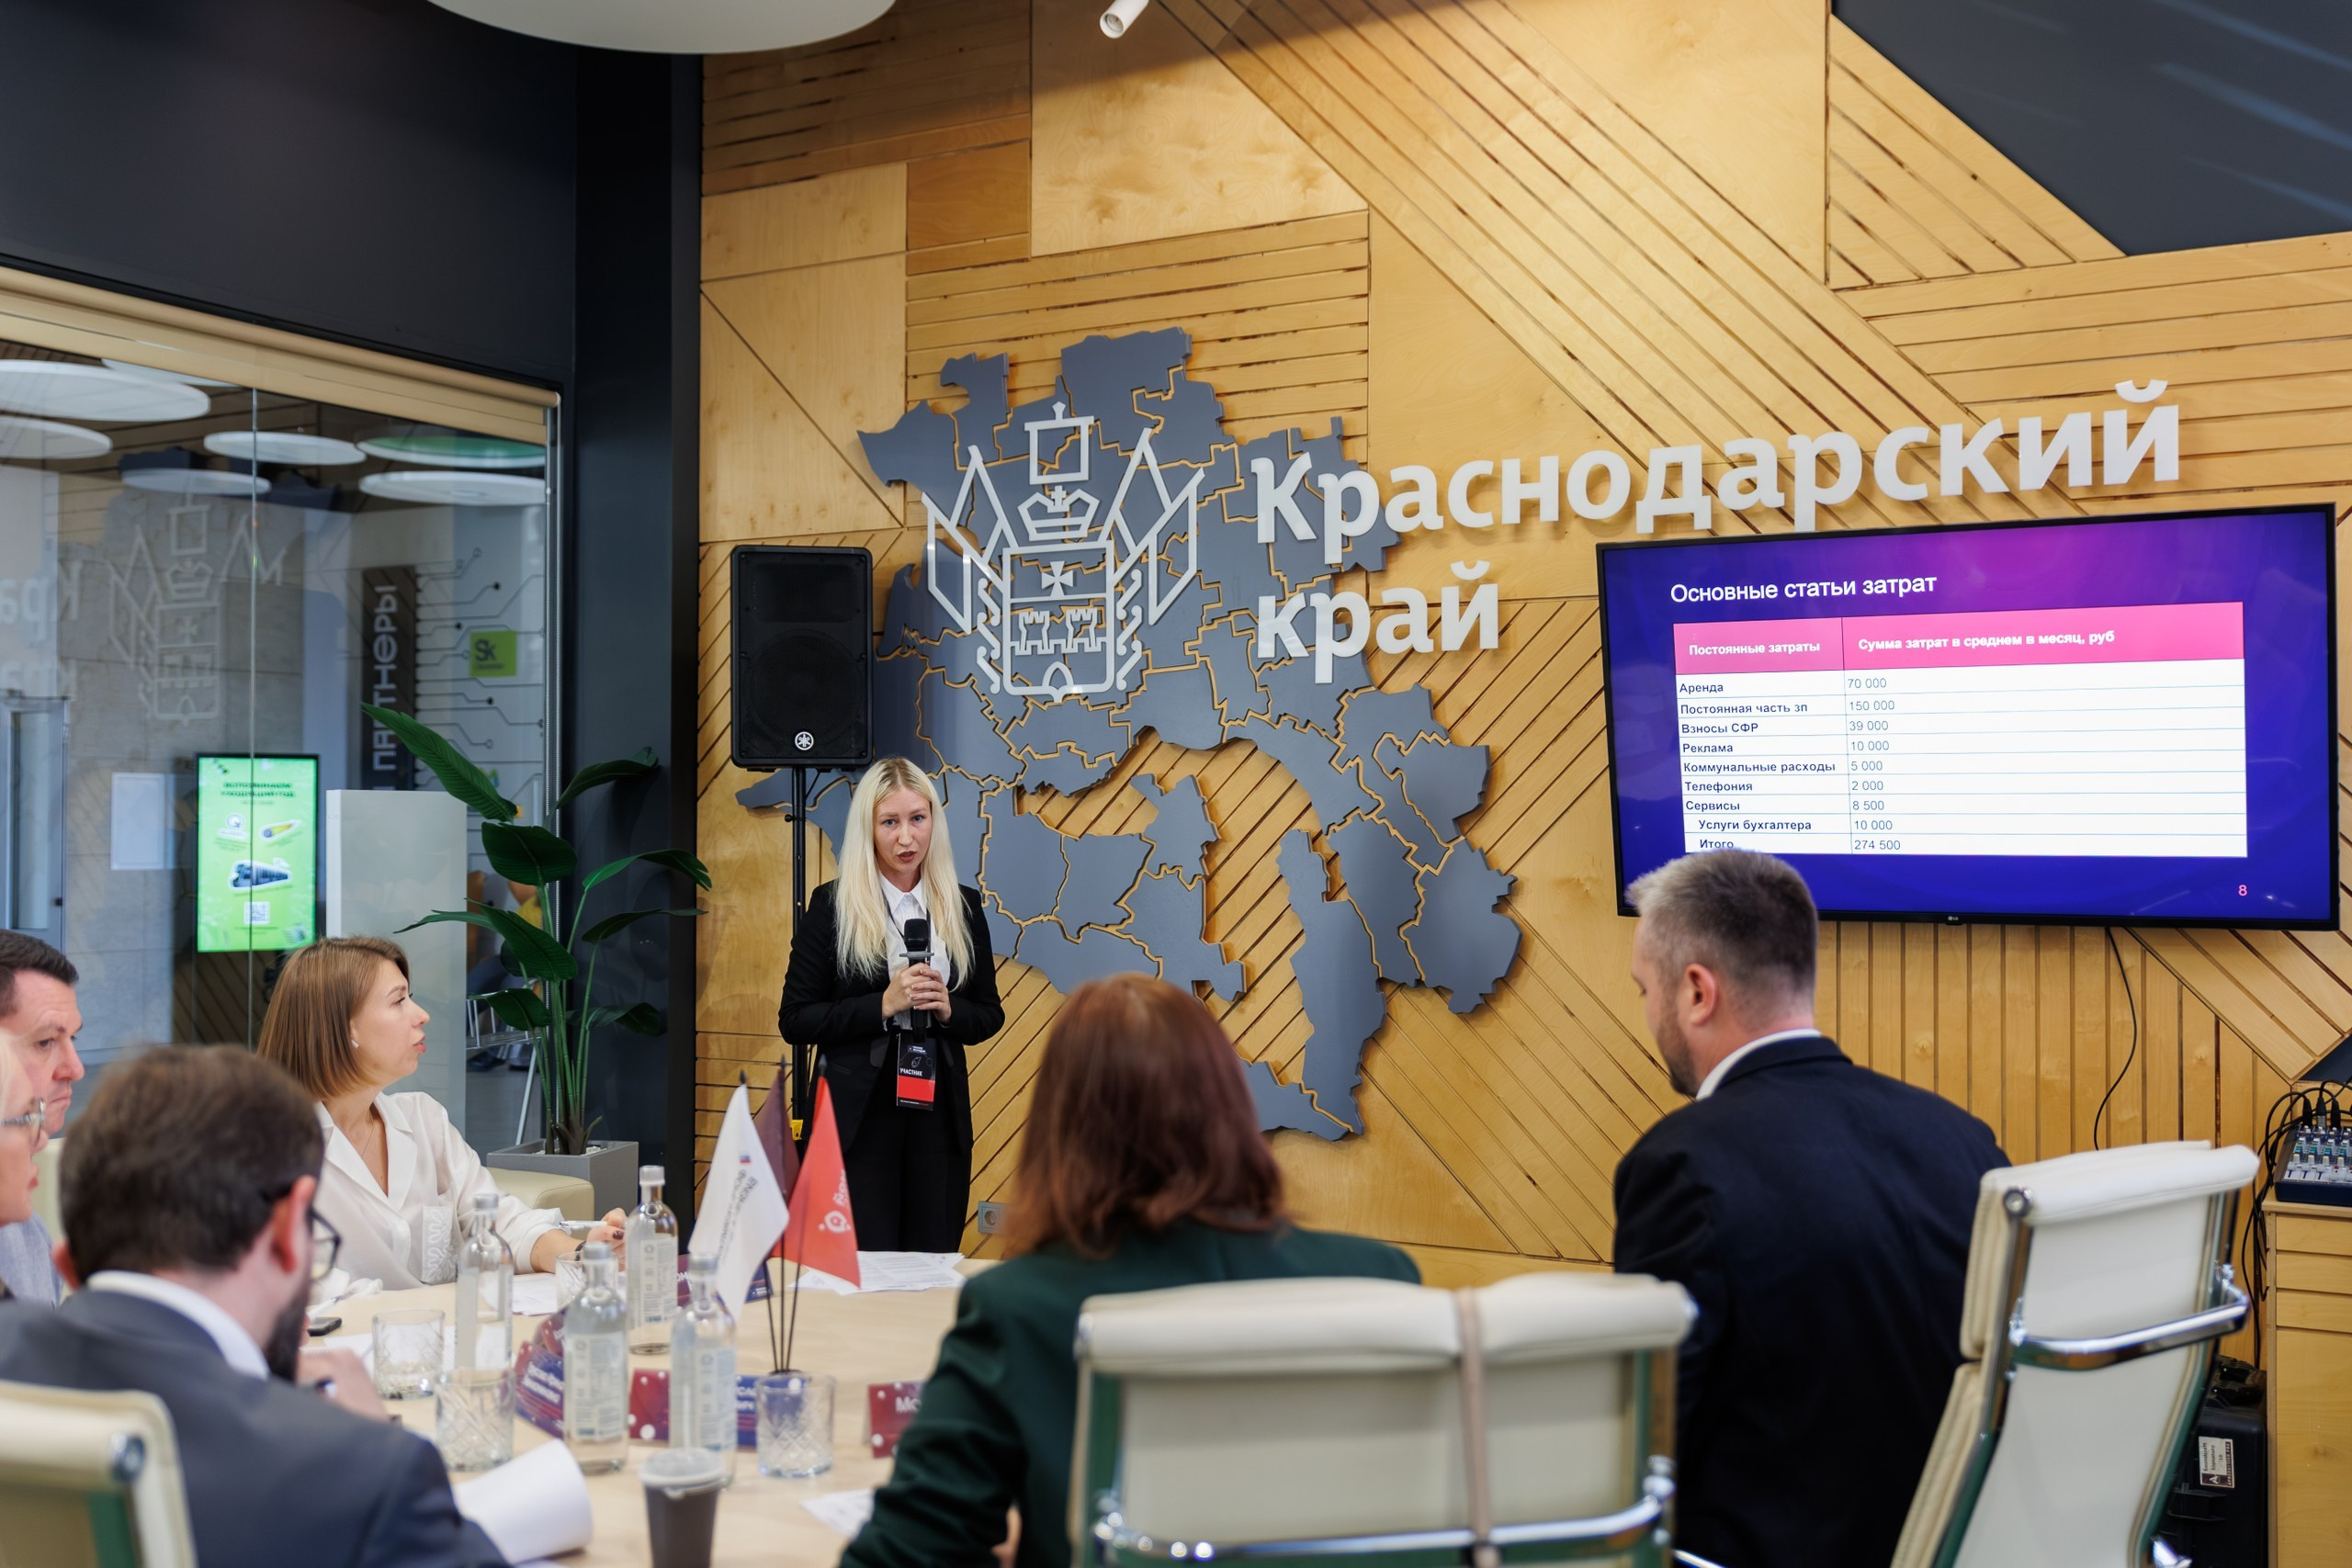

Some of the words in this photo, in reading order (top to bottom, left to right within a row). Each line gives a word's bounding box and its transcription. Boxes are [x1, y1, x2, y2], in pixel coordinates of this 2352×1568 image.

[1250, 379, 2178, 564] Краснодарский
[1670, 583, 1778, 603] Основные
[1784, 580, 1856, 599] статьи
[1862, 576, 1937, 597] затрат
[1258, 560, 1498, 683] край
[1858, 638, 1902, 653] Сумма
[1905, 637, 1949, 650] затрат
[1952, 638, 1961, 648] в
[1963, 636, 2022, 649] среднем
[2026, 635, 2035, 645] в
[2039, 632, 2086, 646] месяц,
[2089, 630, 2115, 645] руб
[1689, 644, 1765, 656] Постоянные
[1769, 643, 1820, 655] затраты
[1679, 682, 1724, 694] Аренда
[1848, 679, 1861, 689] 70
[1865, 678, 1887, 688] 000
[1680, 704, 1752, 715] Постоянная
[1756, 704, 1791, 713] часть
[1794, 703, 1807, 712] зп
[1849, 701, 1870, 711] 150
[1873, 700, 1895, 710] 000
[1681, 724, 1727, 733] Взносы
[1731, 723, 1758, 733] СФР
[1849, 721, 1863, 730] 39
[1867, 720, 1889, 730] 000
[1682, 743, 1734, 753] Реклама
[1850, 741, 1864, 750] 10
[1868, 741, 1890, 750] 000
[1683, 762, 1777, 773] Коммунальные
[1781, 761, 1836, 773] расходы
[1850, 761, 1858, 771] 5
[1861, 761, 1883, 771] 000
[1685, 782, 1753, 793] Телефония
[1851, 781, 1859, 791] 2
[1862, 781, 1884, 790] 000
[1686, 800, 1740, 812] Сервисы
[1852, 801, 1860, 810] 8
[1863, 800, 1885, 810] 500
[1698, 819, 1740, 831] Услуги
[1743, 819, 1812, 831] бухгалтера
[1855, 820, 1868, 830] 10
[1871, 820, 1893, 830] 000
[1700, 840, 1735, 849] Итого
[1854, 840, 1875, 851] 274
[1879, 840, 1901, 850] 500
[2238, 885, 2247, 897] 8
[899, 1067, 922, 1077] УЧАСТНИК
